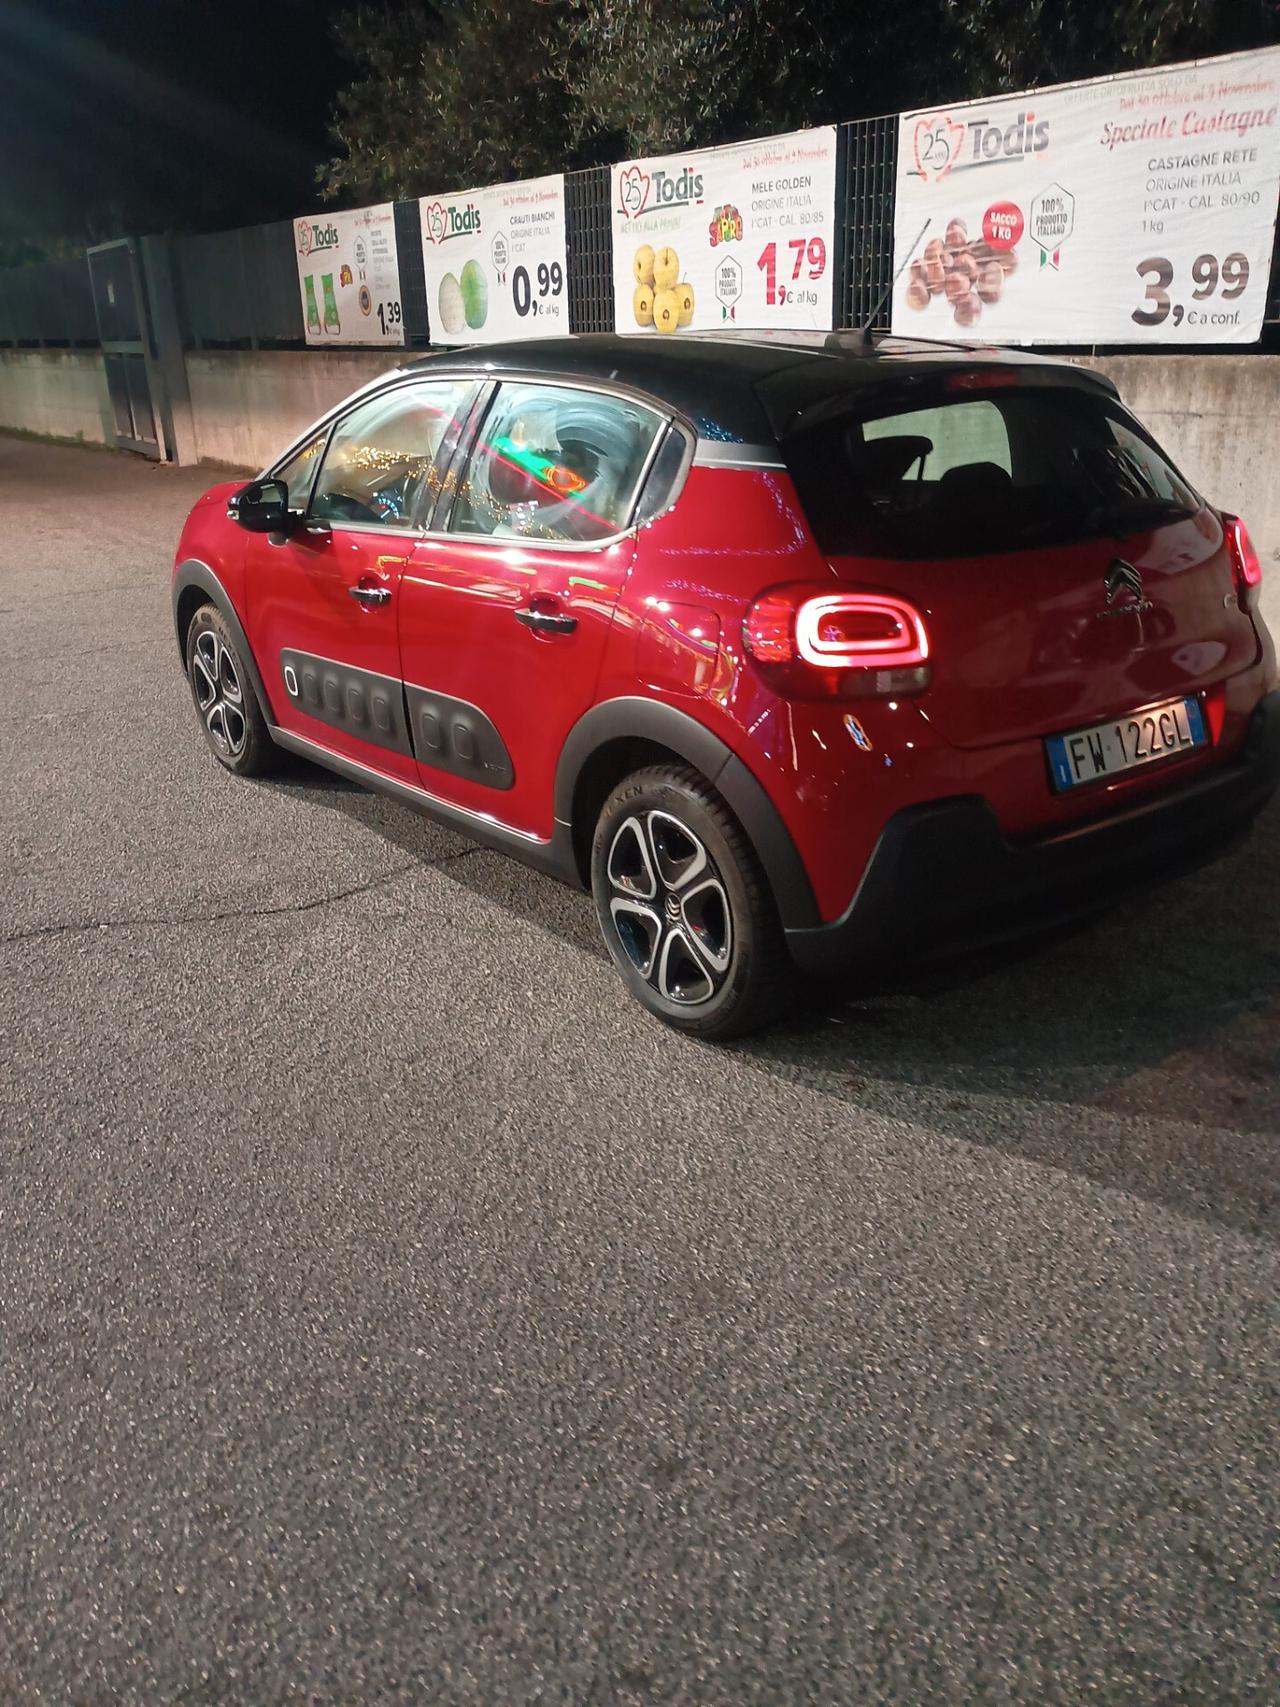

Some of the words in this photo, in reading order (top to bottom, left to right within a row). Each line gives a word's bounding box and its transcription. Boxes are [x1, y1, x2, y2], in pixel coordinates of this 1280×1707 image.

[1100, 115, 1177, 151] Speciale
[1182, 104, 1278, 138] Castagne
[922, 128, 950, 170] 25
[968, 111, 1050, 160] Todis
[1148, 152, 1220, 172] CASTAGNE
[1222, 148, 1258, 164] RETE
[651, 167, 704, 203] Todis
[752, 182, 774, 195] MELE
[775, 176, 812, 191] GOLDEN
[1145, 175, 1199, 192] ORIGINE
[1201, 171, 1242, 188] ITALIA
[752, 196, 785, 212] ORIGINE
[786, 194, 812, 209] ITALIA
[1041, 197, 1065, 213] 100%
[447, 203, 481, 232] Todis
[510, 213, 531, 225] CRAUTI
[531, 211, 556, 223] BIANCHI
[990, 211, 1018, 226] SACCO
[1036, 213, 1068, 226] PRODOTTO
[1150, 219, 1165, 234] kg
[312, 223, 338, 247] Todis
[998, 227, 1012, 240] KG
[1037, 224, 1066, 236] ITALIANO
[806, 290, 818, 306] kg
[1069, 731, 1107, 780] FW
[1115, 709, 1190, 763] 122GL
